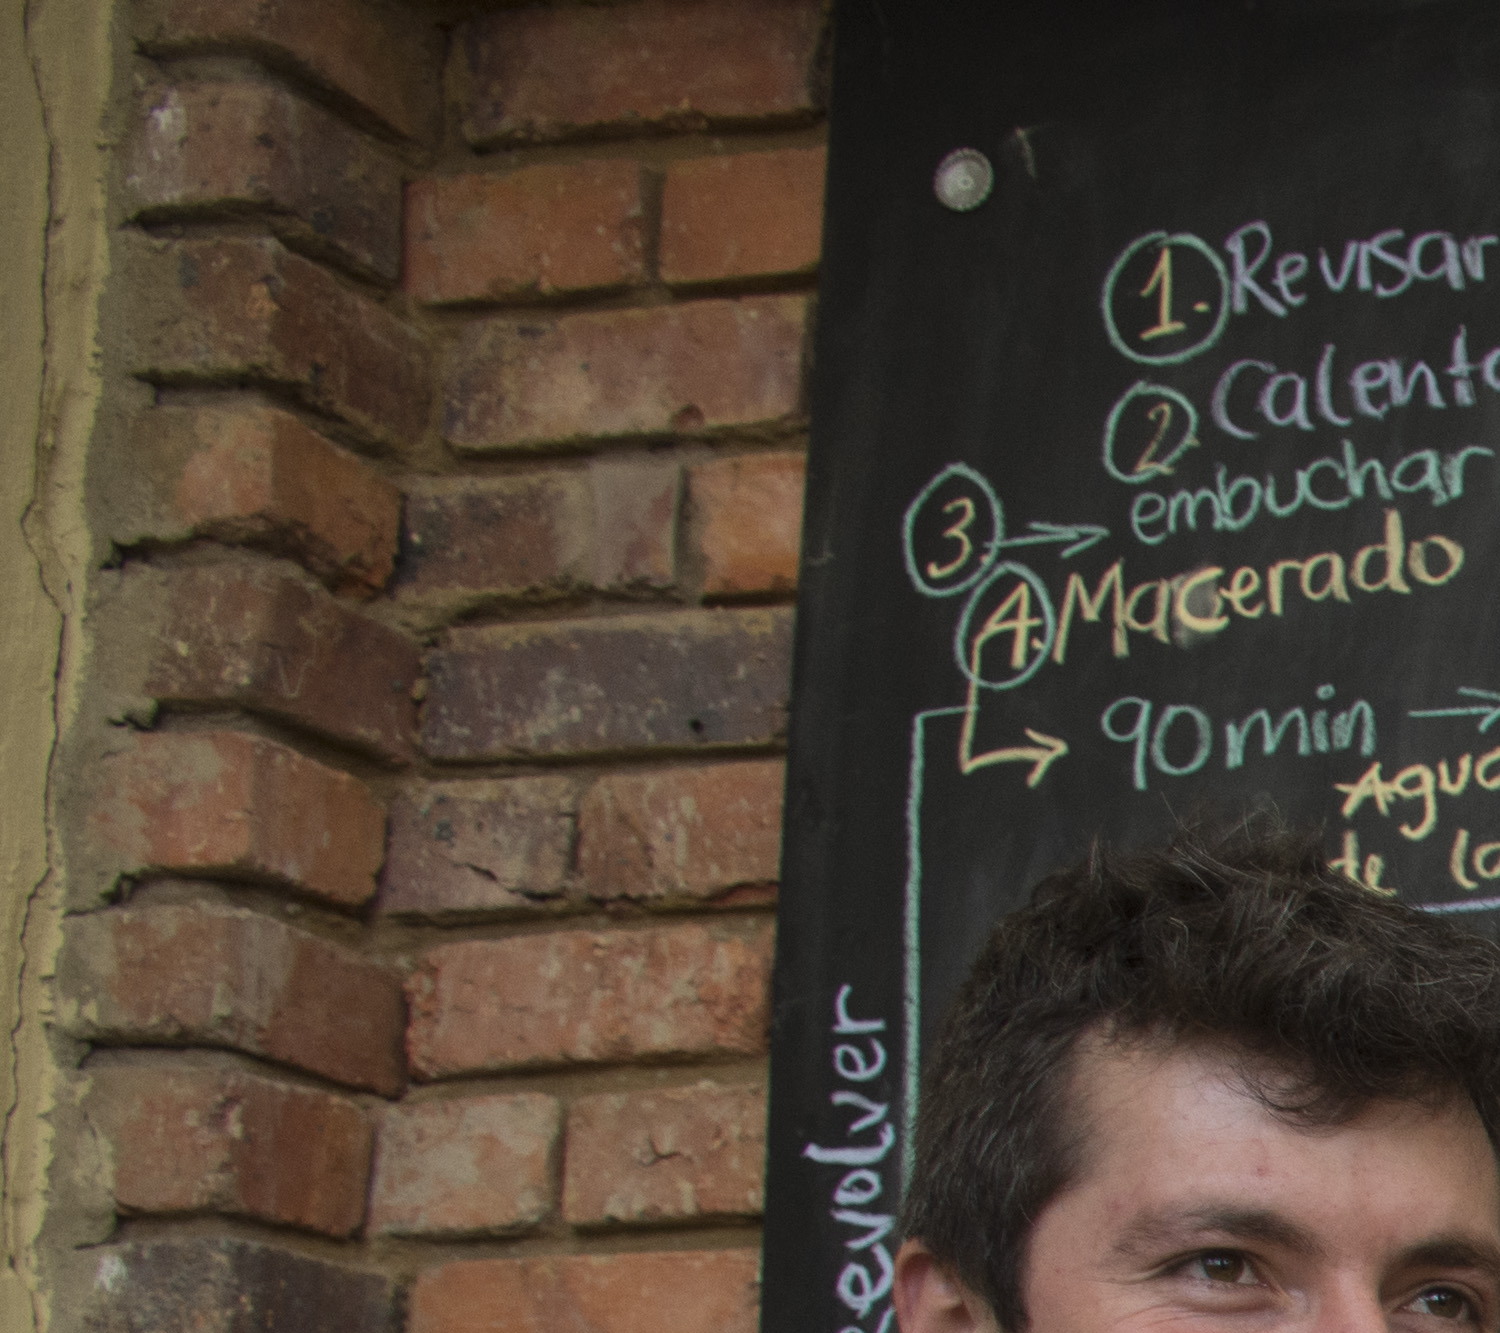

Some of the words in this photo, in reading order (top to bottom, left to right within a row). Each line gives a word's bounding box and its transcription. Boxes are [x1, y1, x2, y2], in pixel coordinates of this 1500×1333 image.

[1225, 219, 1500, 315] Revisar
[1132, 434, 1494, 545] embuchar
[1053, 508, 1464, 664] Macerado
